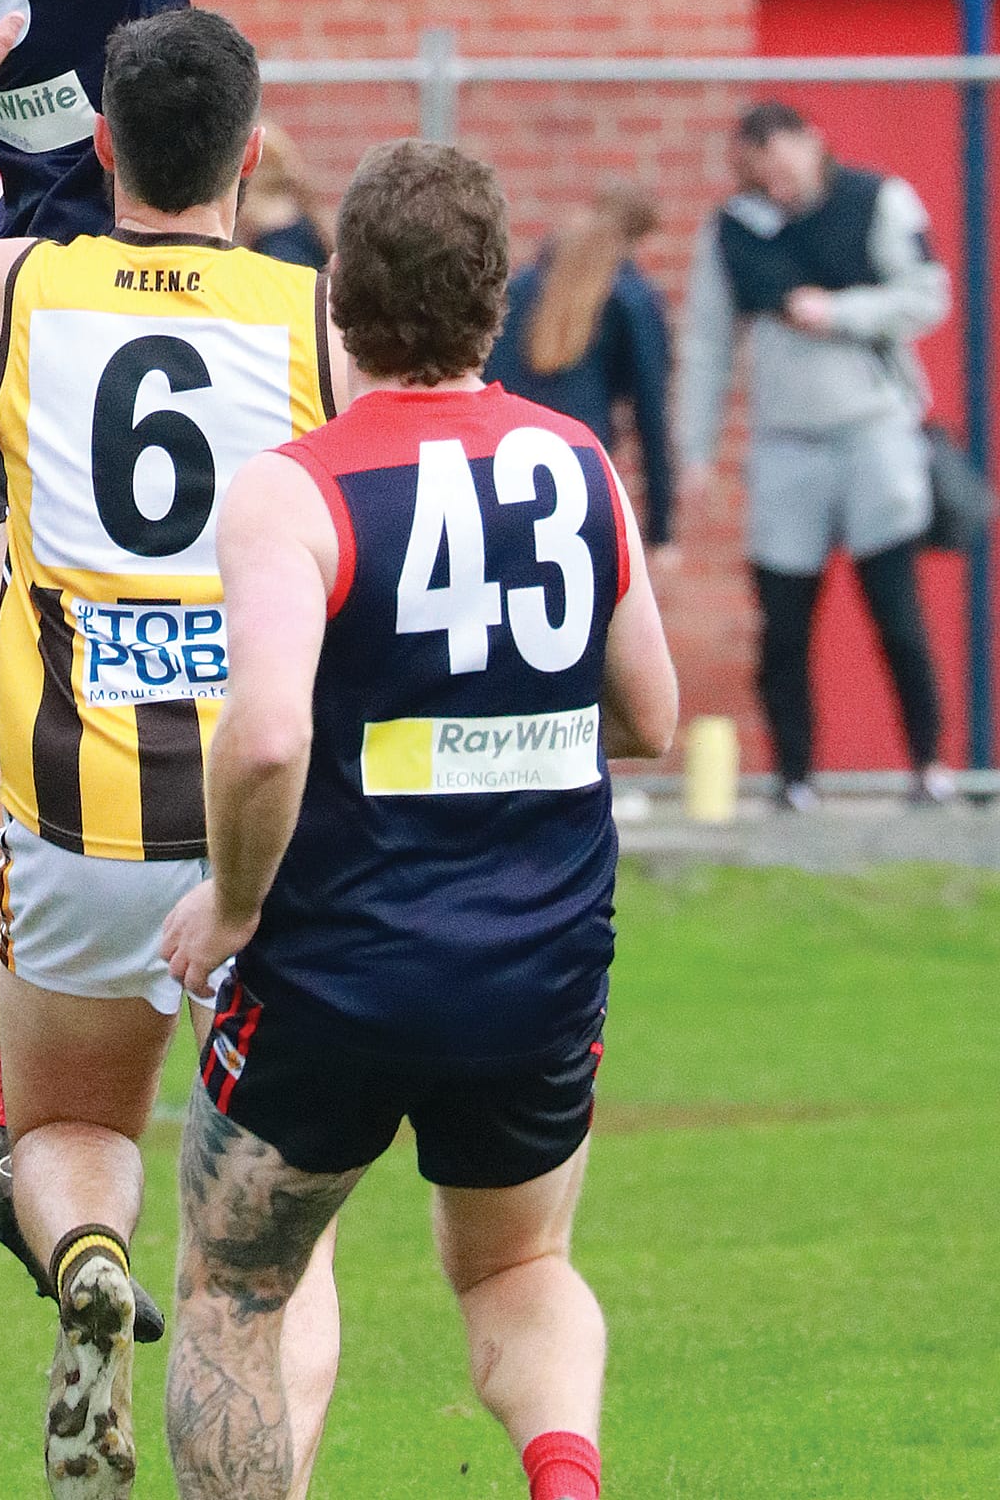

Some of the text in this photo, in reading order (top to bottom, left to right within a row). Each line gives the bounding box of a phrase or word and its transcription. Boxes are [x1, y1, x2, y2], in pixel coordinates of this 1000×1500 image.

[114, 269, 205, 292] M.E.F.N.C.
[91, 334, 216, 558] 6
[395, 426, 596, 676] 43
[98, 610, 223, 645] TOP
[89, 639, 229, 686] PUB
[436, 770, 542, 789] LEONGATHA
